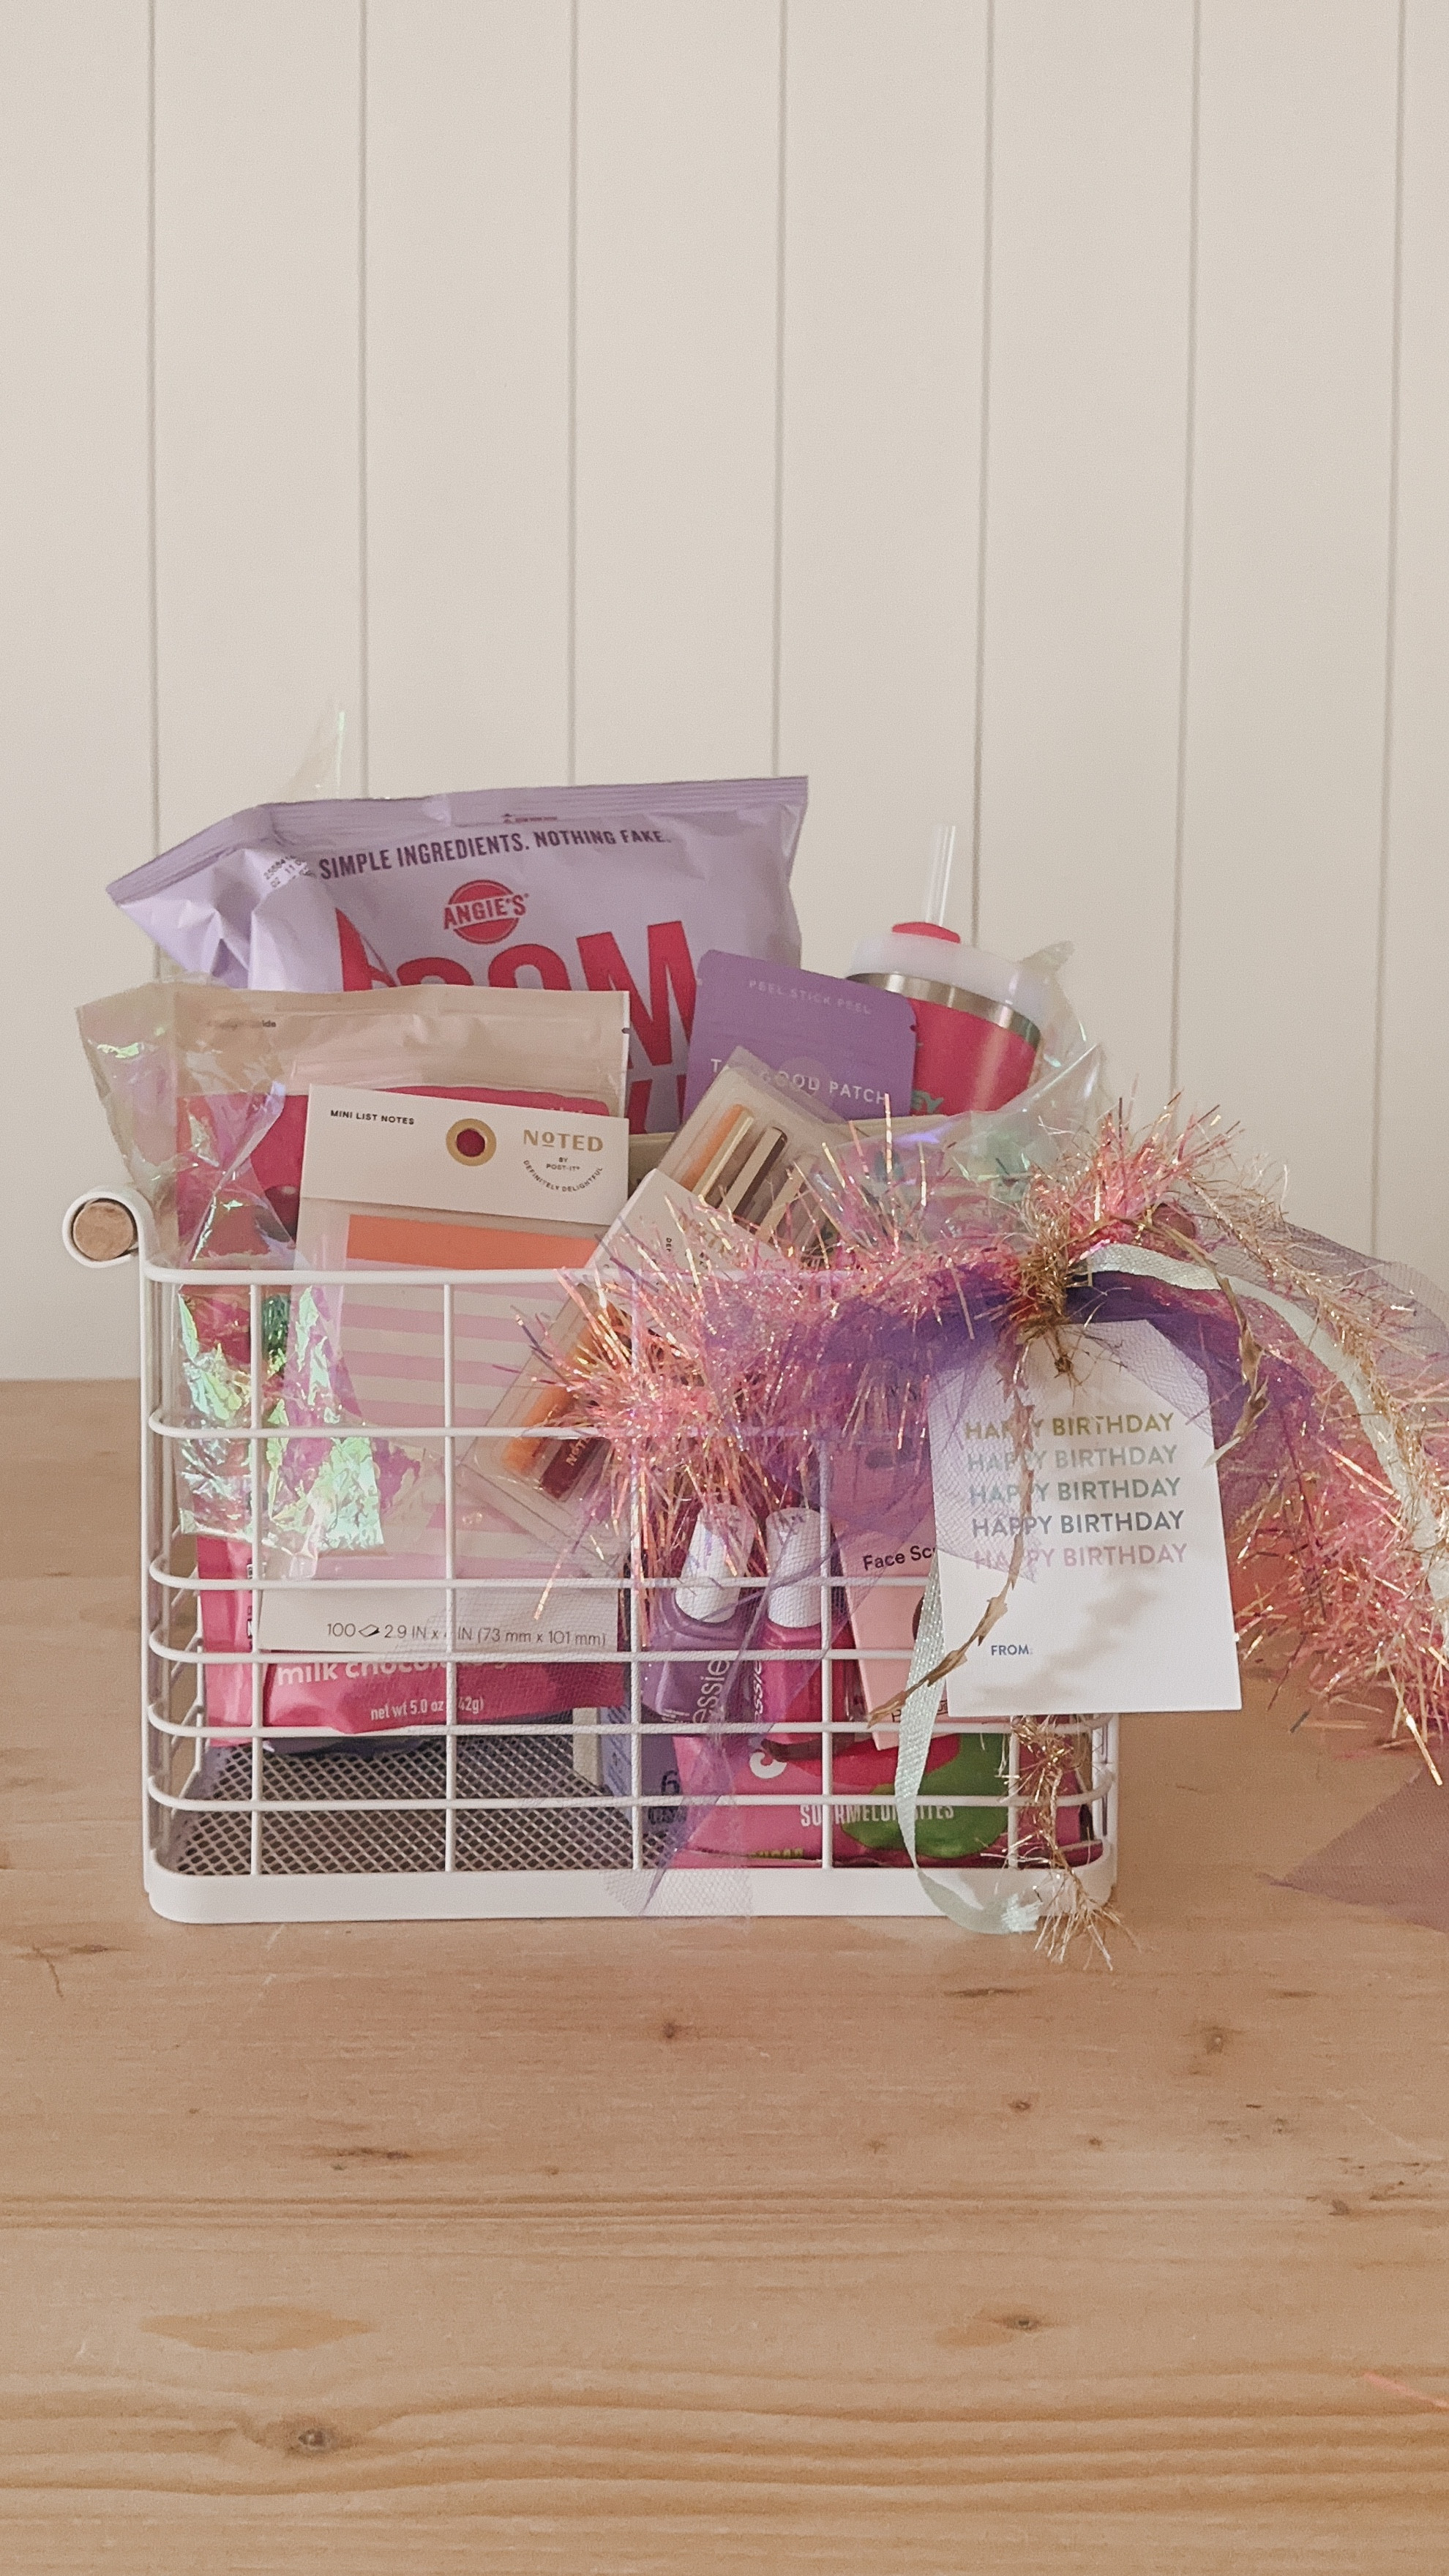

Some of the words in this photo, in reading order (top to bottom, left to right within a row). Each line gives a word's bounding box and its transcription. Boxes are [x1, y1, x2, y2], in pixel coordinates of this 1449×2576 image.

[319, 850, 392, 880] SIMPLE
[396, 833, 529, 867] INGREDIENTS.
[533, 830, 617, 848] NOTHING
[443, 894, 526, 929] ANGIE'S
[829, 1080, 888, 1104] PATCH
[331, 1109, 353, 1118] MINI
[356, 1112, 378, 1121] LIST
[381, 1115, 415, 1125] NOTES
[523, 1129, 604, 1152] NOTED
[523, 1160, 560, 1190] DEFINITELY
[562, 1167, 603, 1192] DELIGHTFUL
[965, 1418, 1044, 1440] HAY
[1052, 1412, 1175, 1437] BIRTHDAY
[1055, 1445, 1177, 1469] BIRTHDAY
[970, 1483, 1050, 1504] HAPY
[1058, 1478, 1180, 1502] BIRTHDAY
[972, 1516, 1052, 1538] HAPPY
[1060, 1510, 1184, 1534] BIRTHDAY
[863, 1553, 905, 1571] Face
[974, 1548, 1055, 1570] HAPY
[1063, 1543, 1187, 1567] BIRTHDAY
[327, 1623, 356, 1637] 100
[412, 1625, 427, 1639] IN
[458, 1627, 472, 1640] IN
[478, 1628, 501, 1643] (73
[505, 1632, 531, 1642] mm
[550, 1630, 570, 1644] 101
[575, 1633, 606, 1646] mm)
[278, 1662, 338, 1685] milk
[370, 1703, 390, 1721] net
[392, 1700, 408, 1718] wt
[410, 1699, 427, 1715] 5.0
[430, 1701, 444, 1712] oz
[457, 1696, 484, 1714] 42g)
[800, 1805, 898, 1827] SORMELO
[915, 1805, 954, 1820] ITES
